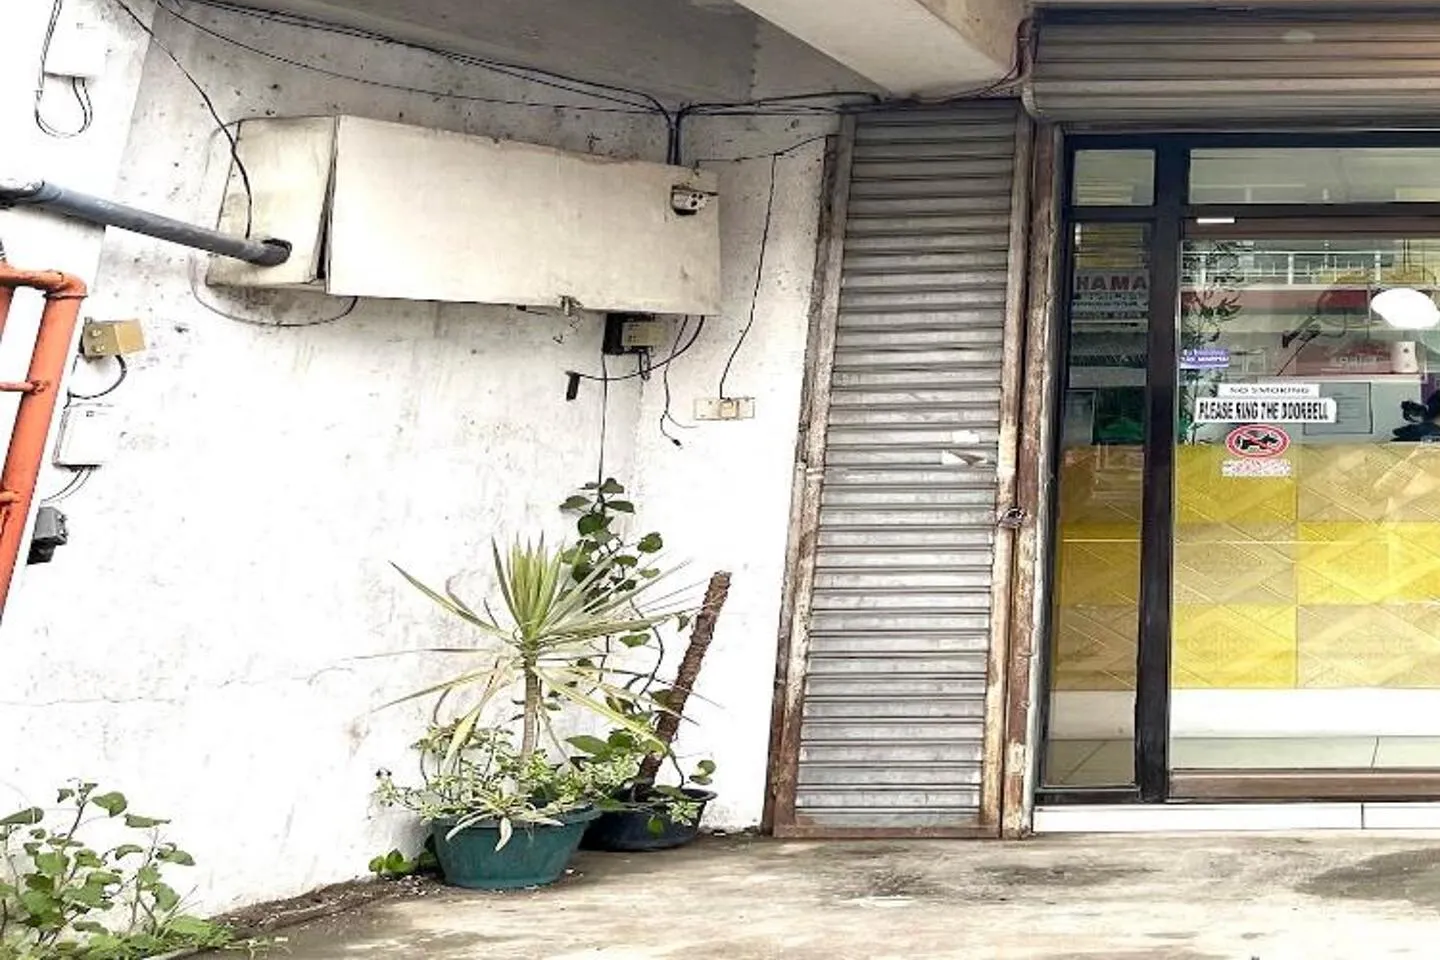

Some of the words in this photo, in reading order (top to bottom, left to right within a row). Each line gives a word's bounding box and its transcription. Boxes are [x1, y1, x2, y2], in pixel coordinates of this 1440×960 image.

[1199, 401, 1234, 420] PLEASE
[1235, 401, 1259, 420] RING
[1260, 401, 1279, 420] THE
[1281, 401, 1329, 420] DOORBELL
